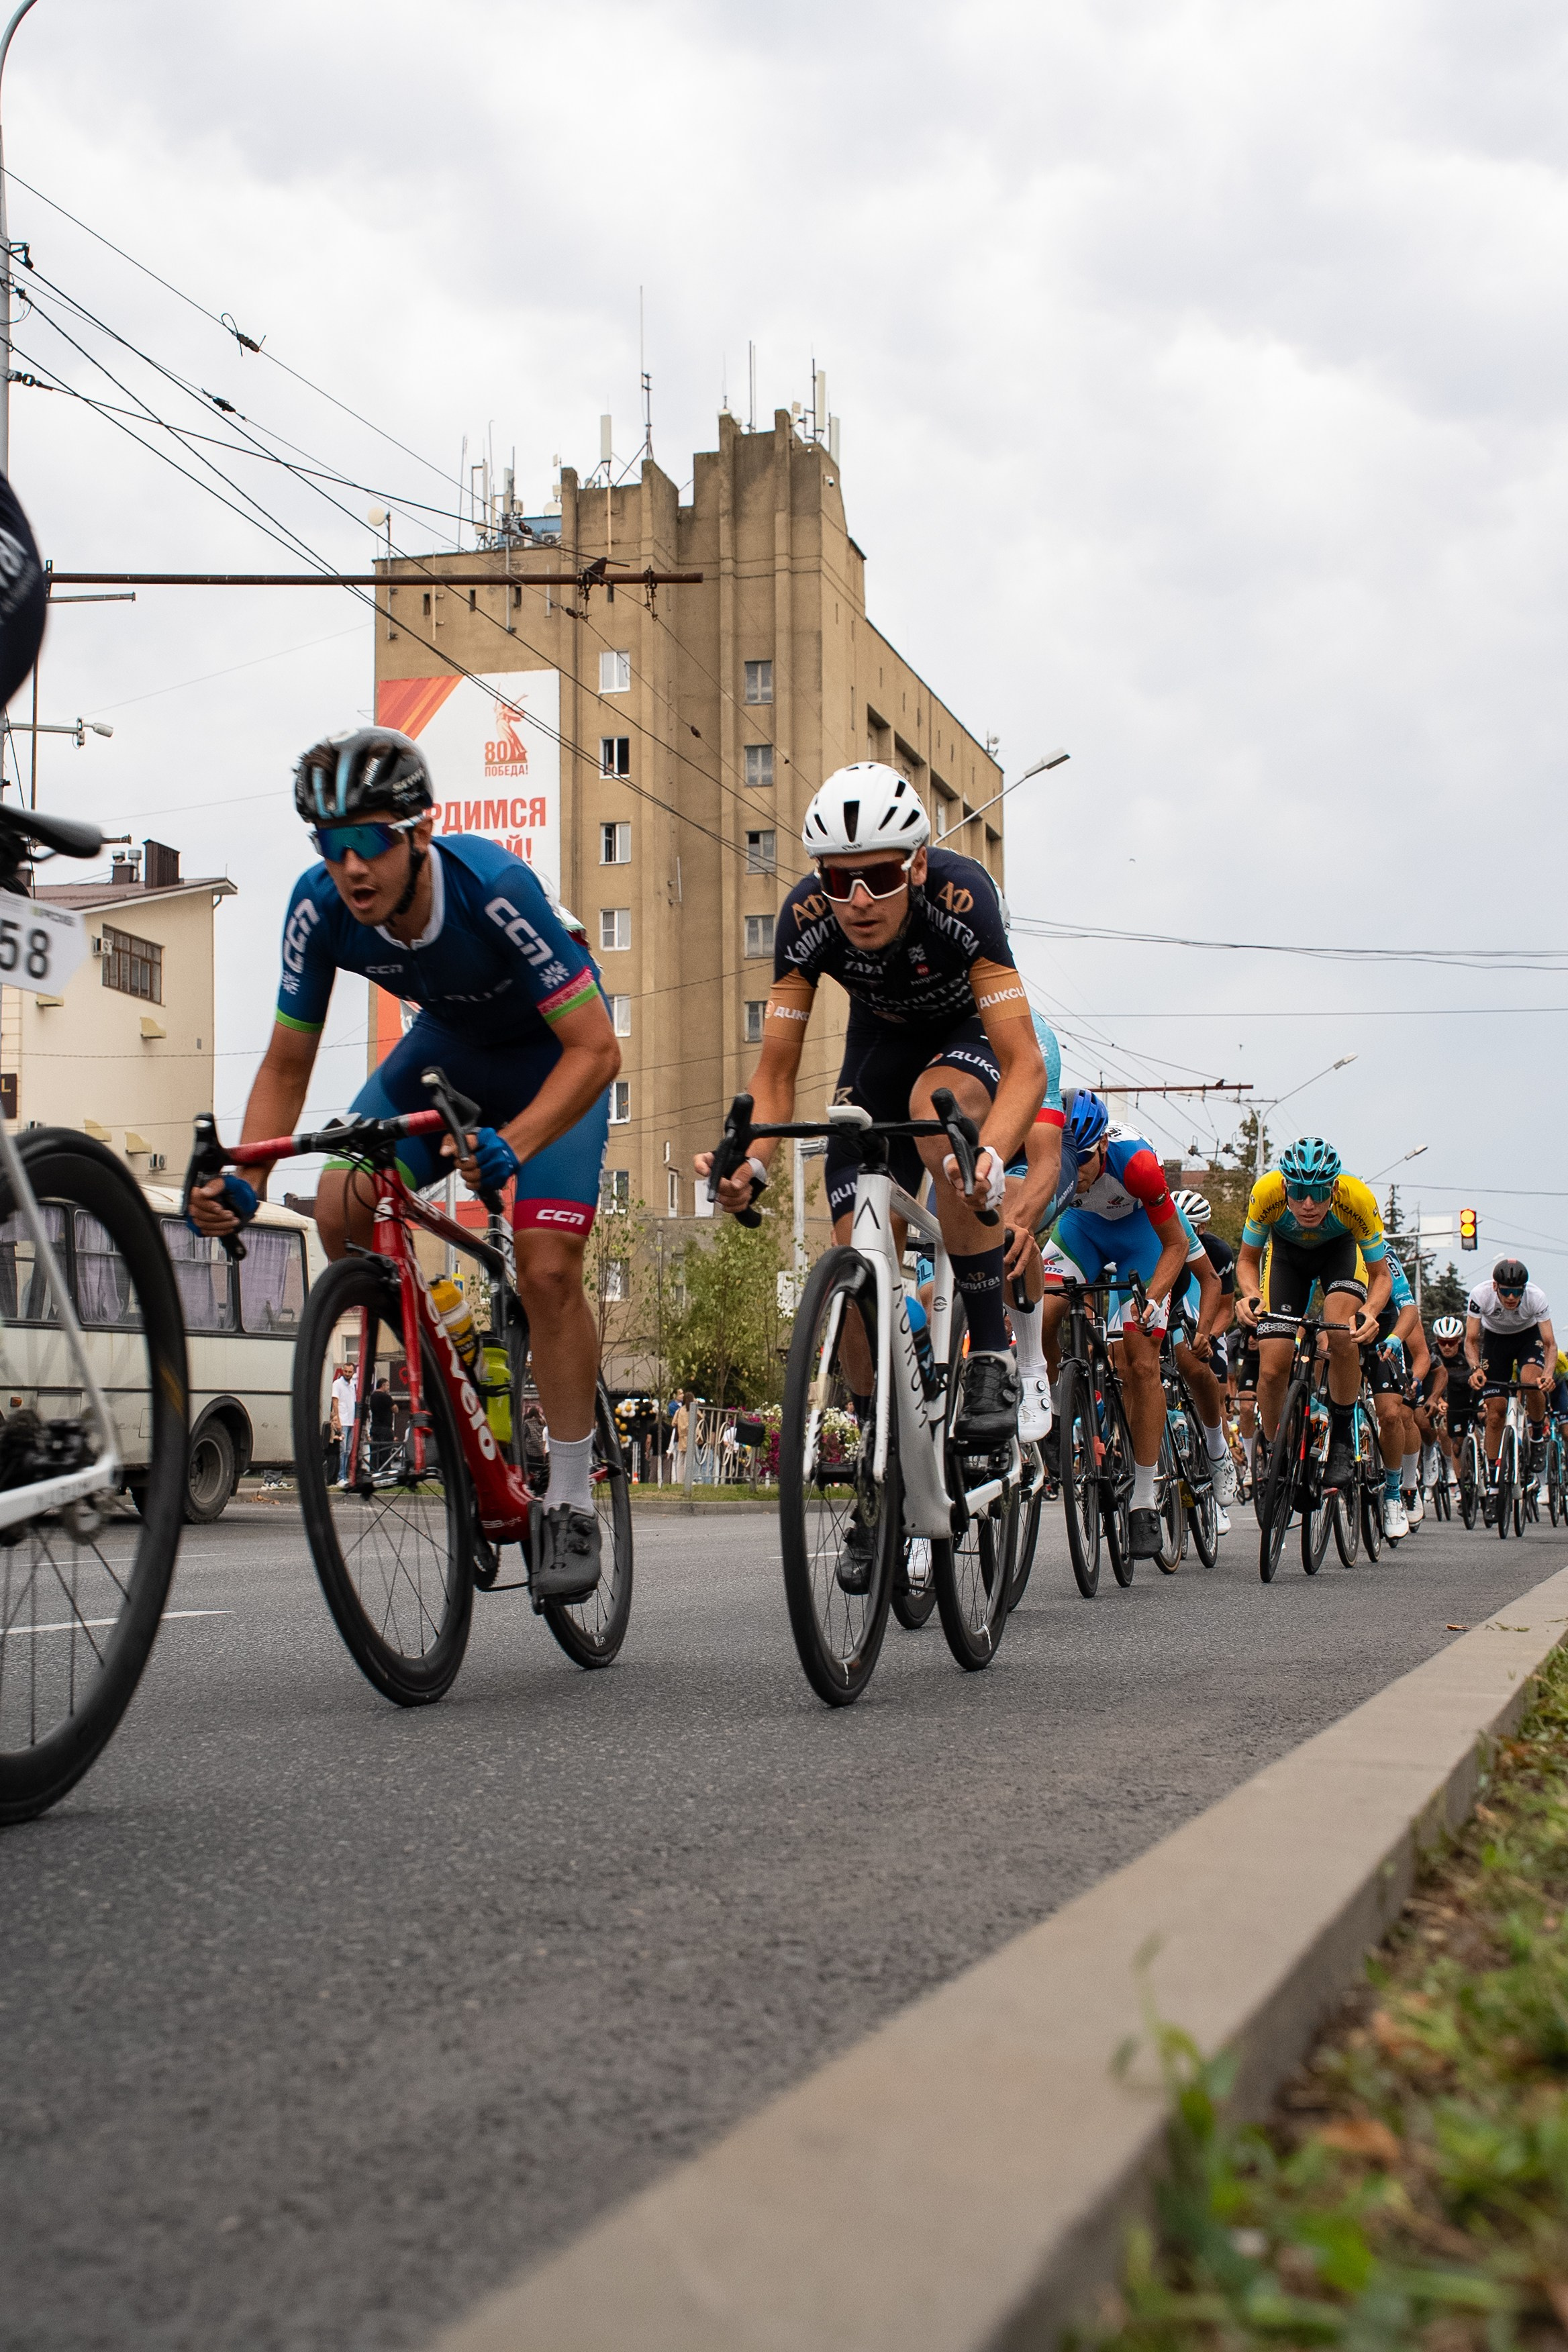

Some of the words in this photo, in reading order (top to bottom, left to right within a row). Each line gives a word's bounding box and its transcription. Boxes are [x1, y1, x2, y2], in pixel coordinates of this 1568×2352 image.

[485, 741, 509, 763] 80
[485, 765, 528, 777] ПОБЕДА!
[425, 797, 546, 834] РДИМСЯ
